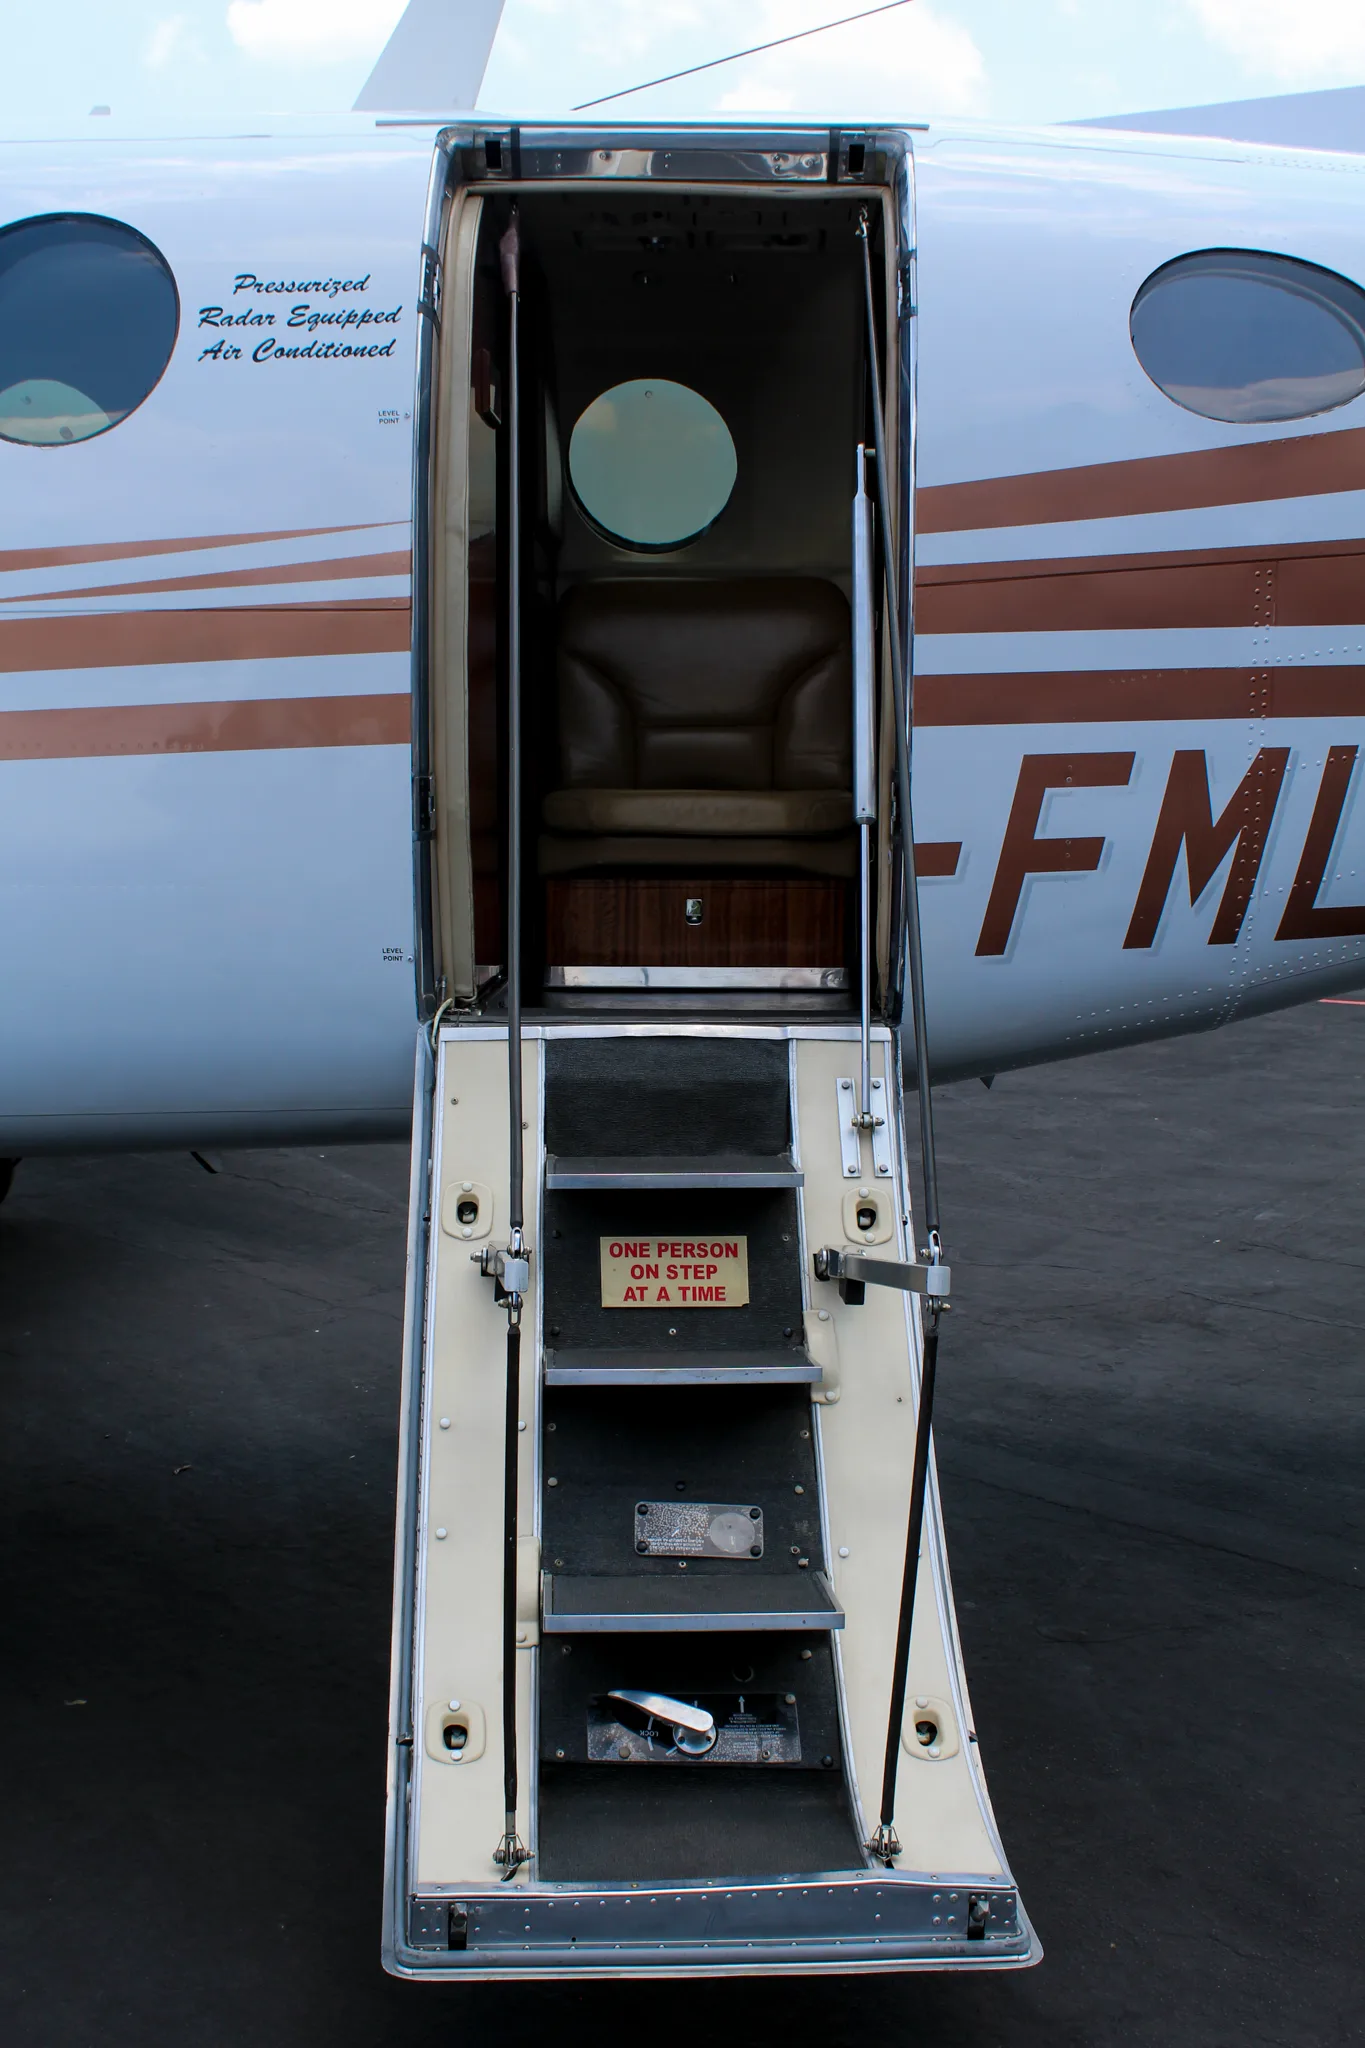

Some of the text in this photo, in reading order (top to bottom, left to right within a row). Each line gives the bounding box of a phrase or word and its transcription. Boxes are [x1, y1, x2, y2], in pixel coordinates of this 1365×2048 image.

[233, 274, 371, 298] Pressurized
[198, 304, 402, 331] Radar Equipped
[197, 337, 396, 363] Air Conditioned
[609, 1242, 738, 1258] ONE PERSON
[630, 1264, 718, 1280] ON STEP
[623, 1286, 727, 1302] AT A TIME
[639, 1729, 659, 1737] LOCK
